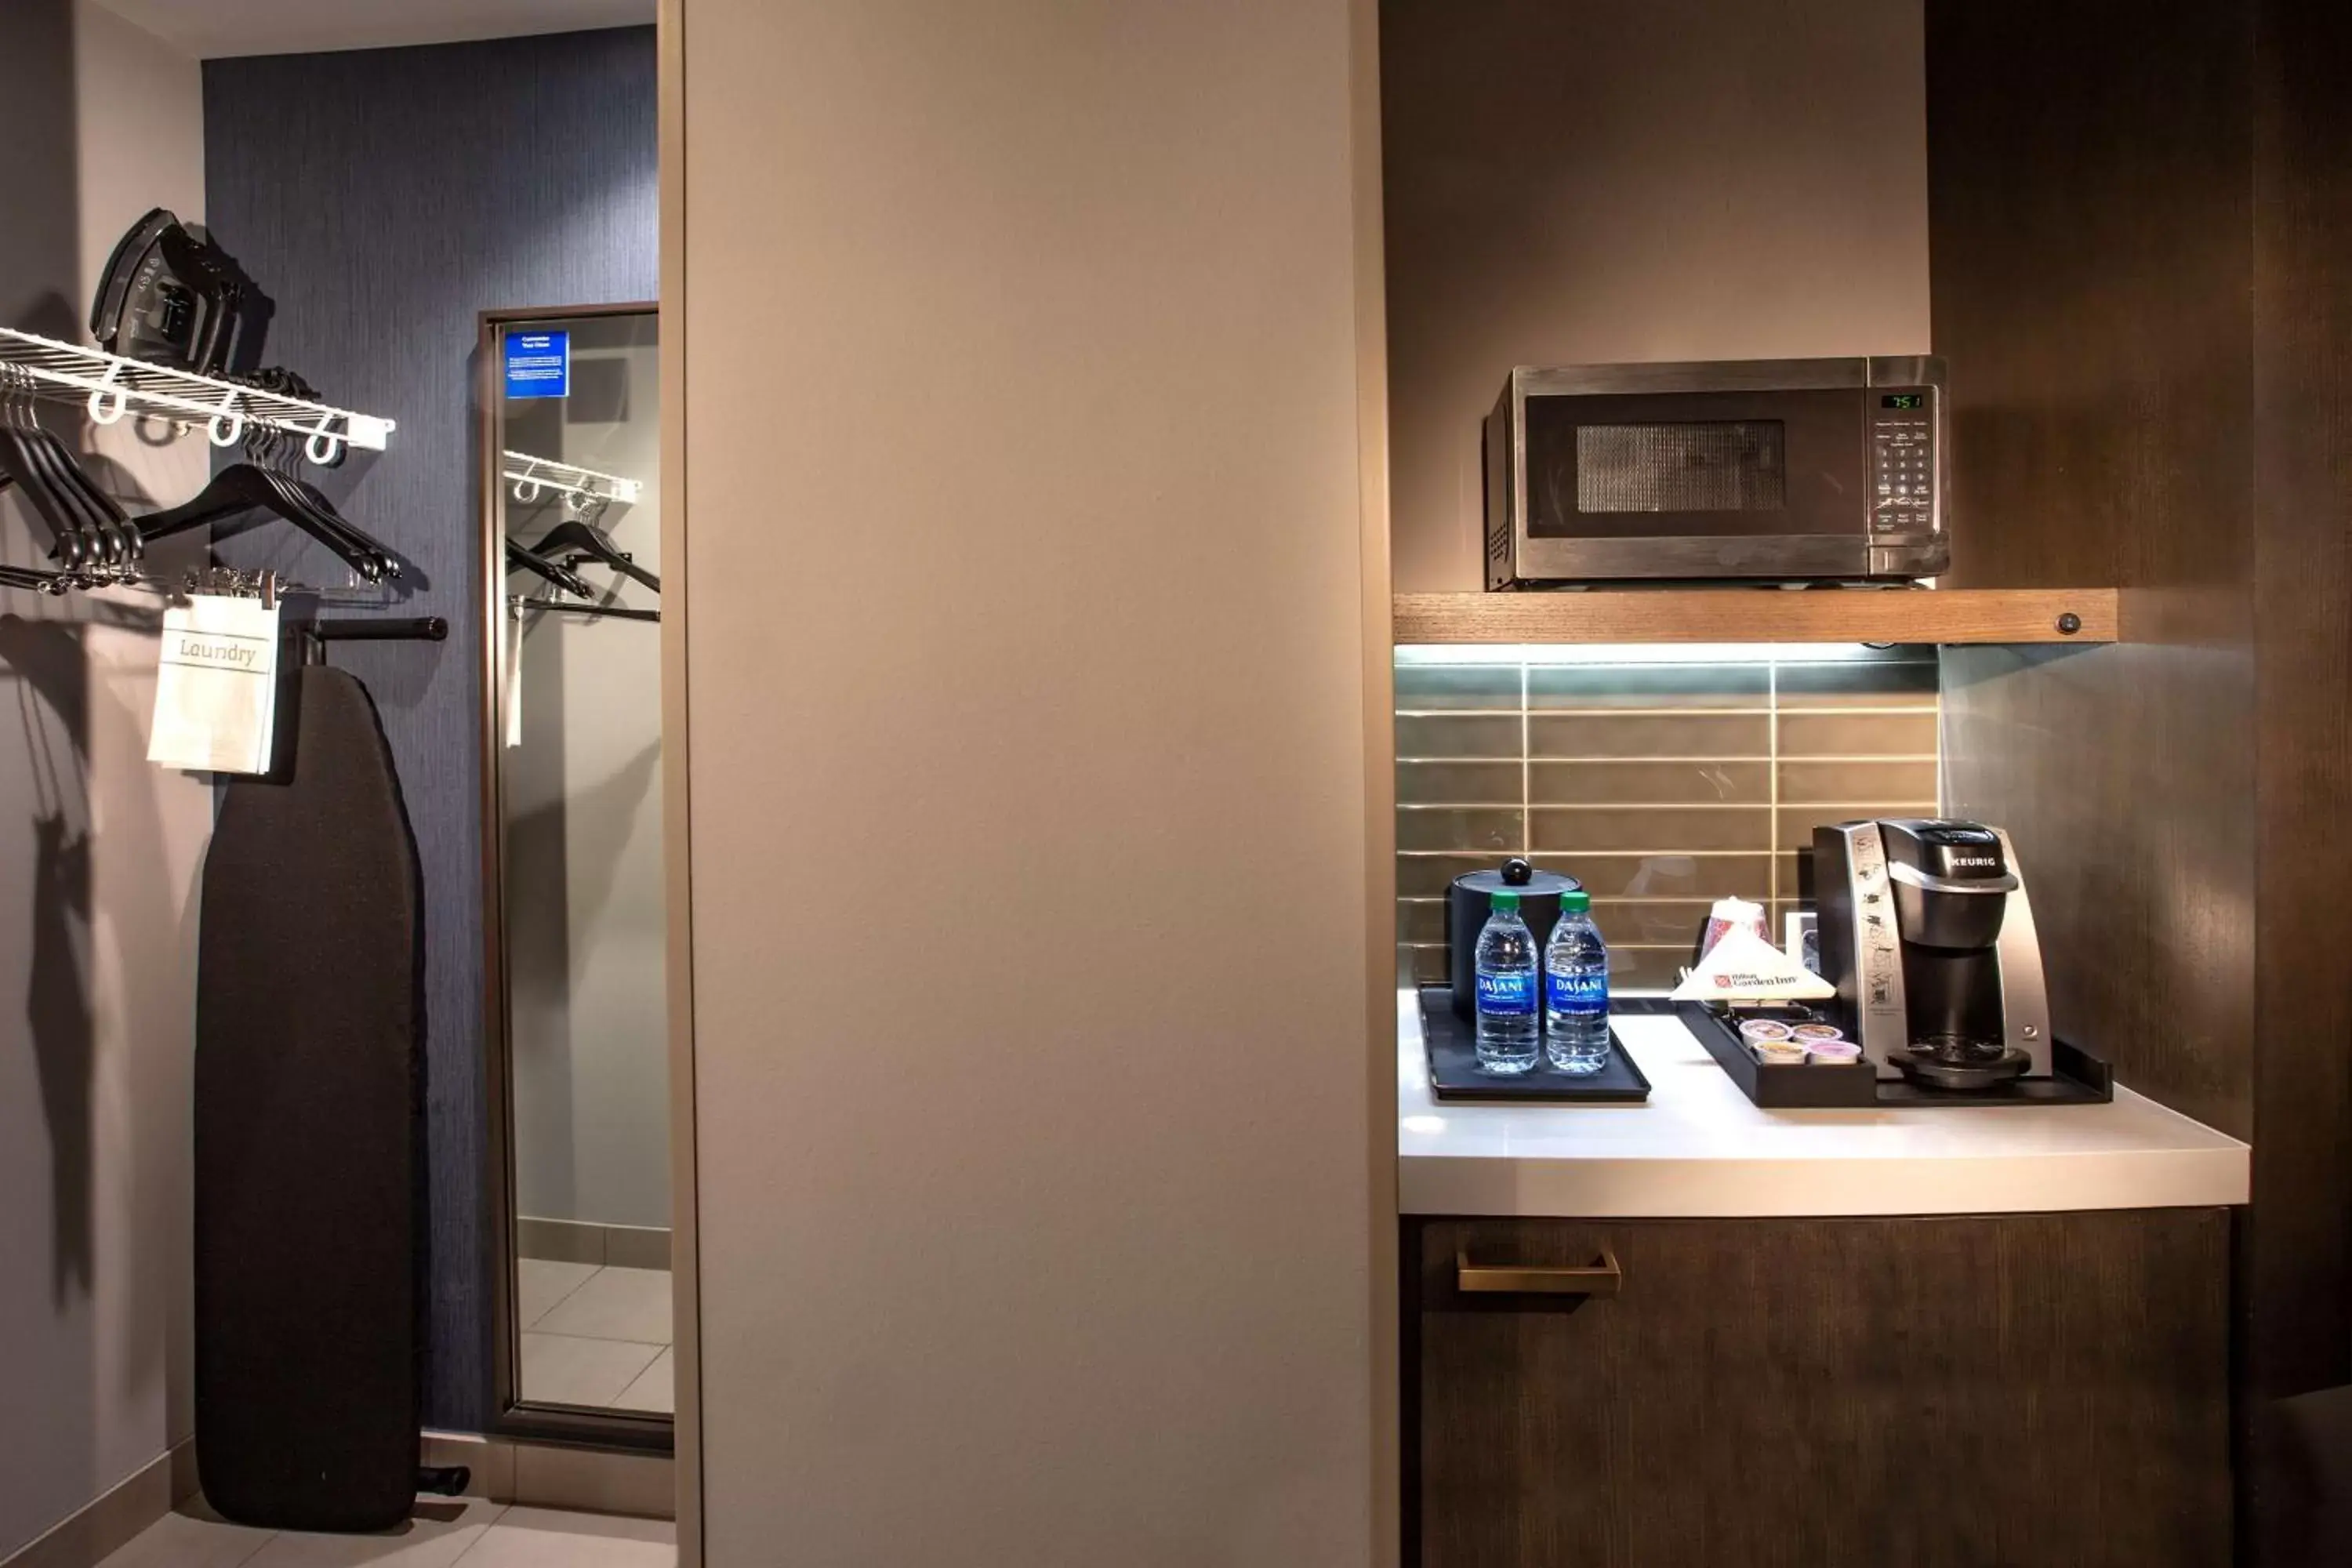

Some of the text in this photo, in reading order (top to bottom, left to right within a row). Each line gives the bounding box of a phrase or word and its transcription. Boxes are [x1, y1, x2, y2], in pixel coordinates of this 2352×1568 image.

[180, 639, 256, 667] Laundry
[1951, 857, 1996, 866] KEURIG
[1479, 978, 1523, 994] DASANI
[1556, 978, 1602, 994] DASANI
[1733, 976, 1797, 987] Garden Inn
